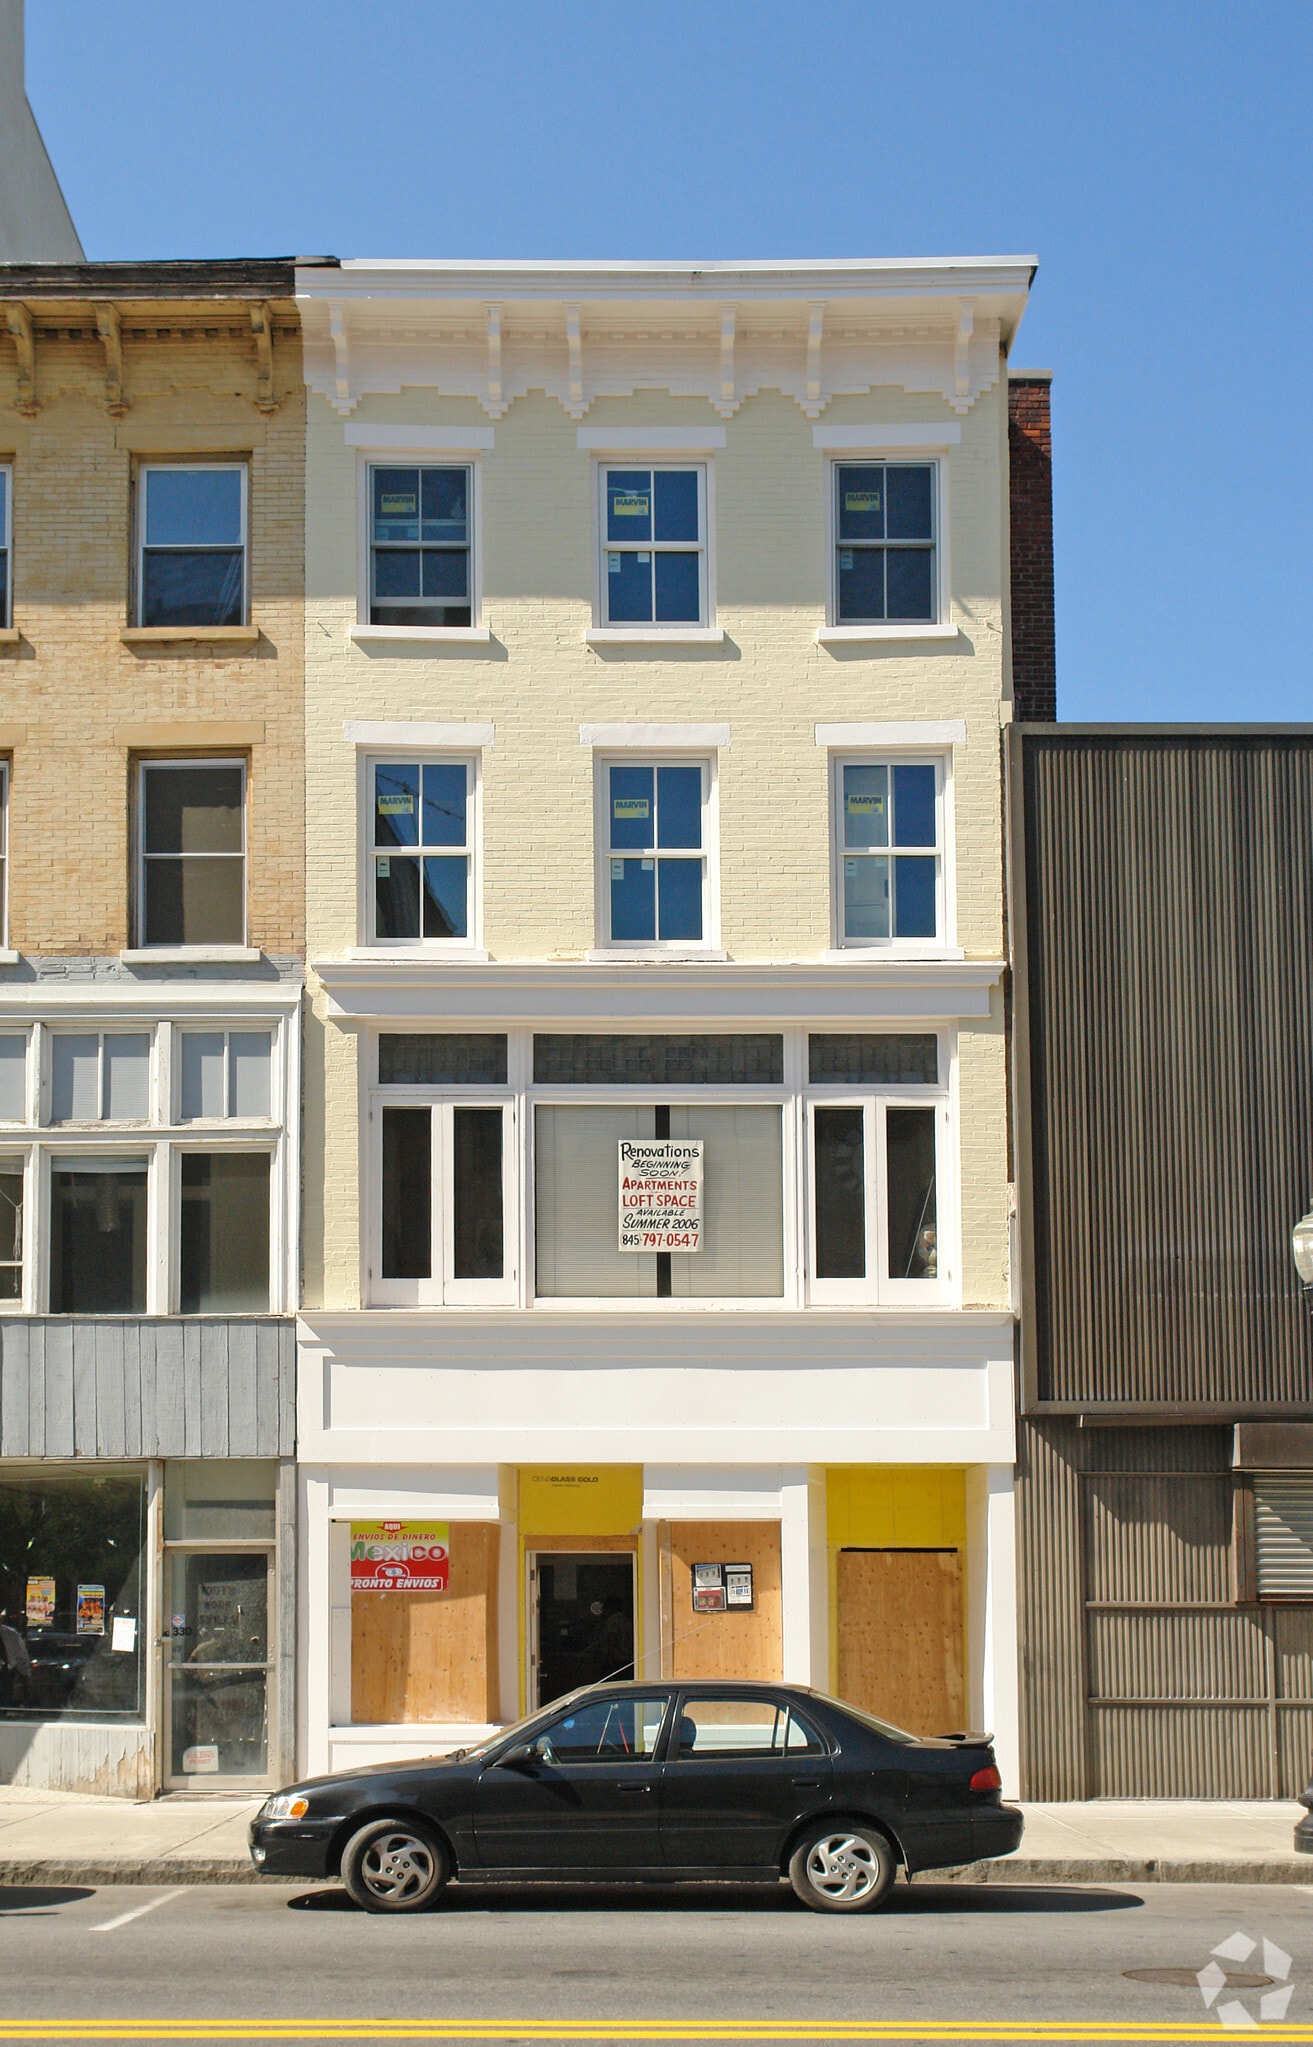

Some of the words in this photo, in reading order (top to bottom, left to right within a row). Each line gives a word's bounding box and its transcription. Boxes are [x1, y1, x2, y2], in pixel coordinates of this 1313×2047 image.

[847, 493, 879, 501] MARVIN
[615, 498, 647, 506] MARVIN
[380, 797, 411, 805] MARVIN
[615, 801, 647, 809] MARVIN
[620, 1142, 700, 1161] Renovations
[632, 1159, 691, 1169] BEGINNING
[622, 1177, 698, 1190] APARTMENTS
[622, 1195, 653, 1207] LOFT
[656, 1195, 697, 1208] SPACE
[622, 1213, 670, 1229] SUMMER
[671, 1218, 700, 1230] 2006
[353, 1533, 385, 1541] ENVIOS
[387, 1533, 399, 1541] DE
[402, 1533, 436, 1541] DINERO
[396, 1579, 440, 1588] ENVIOS
[172, 1626, 192, 1636] 330
